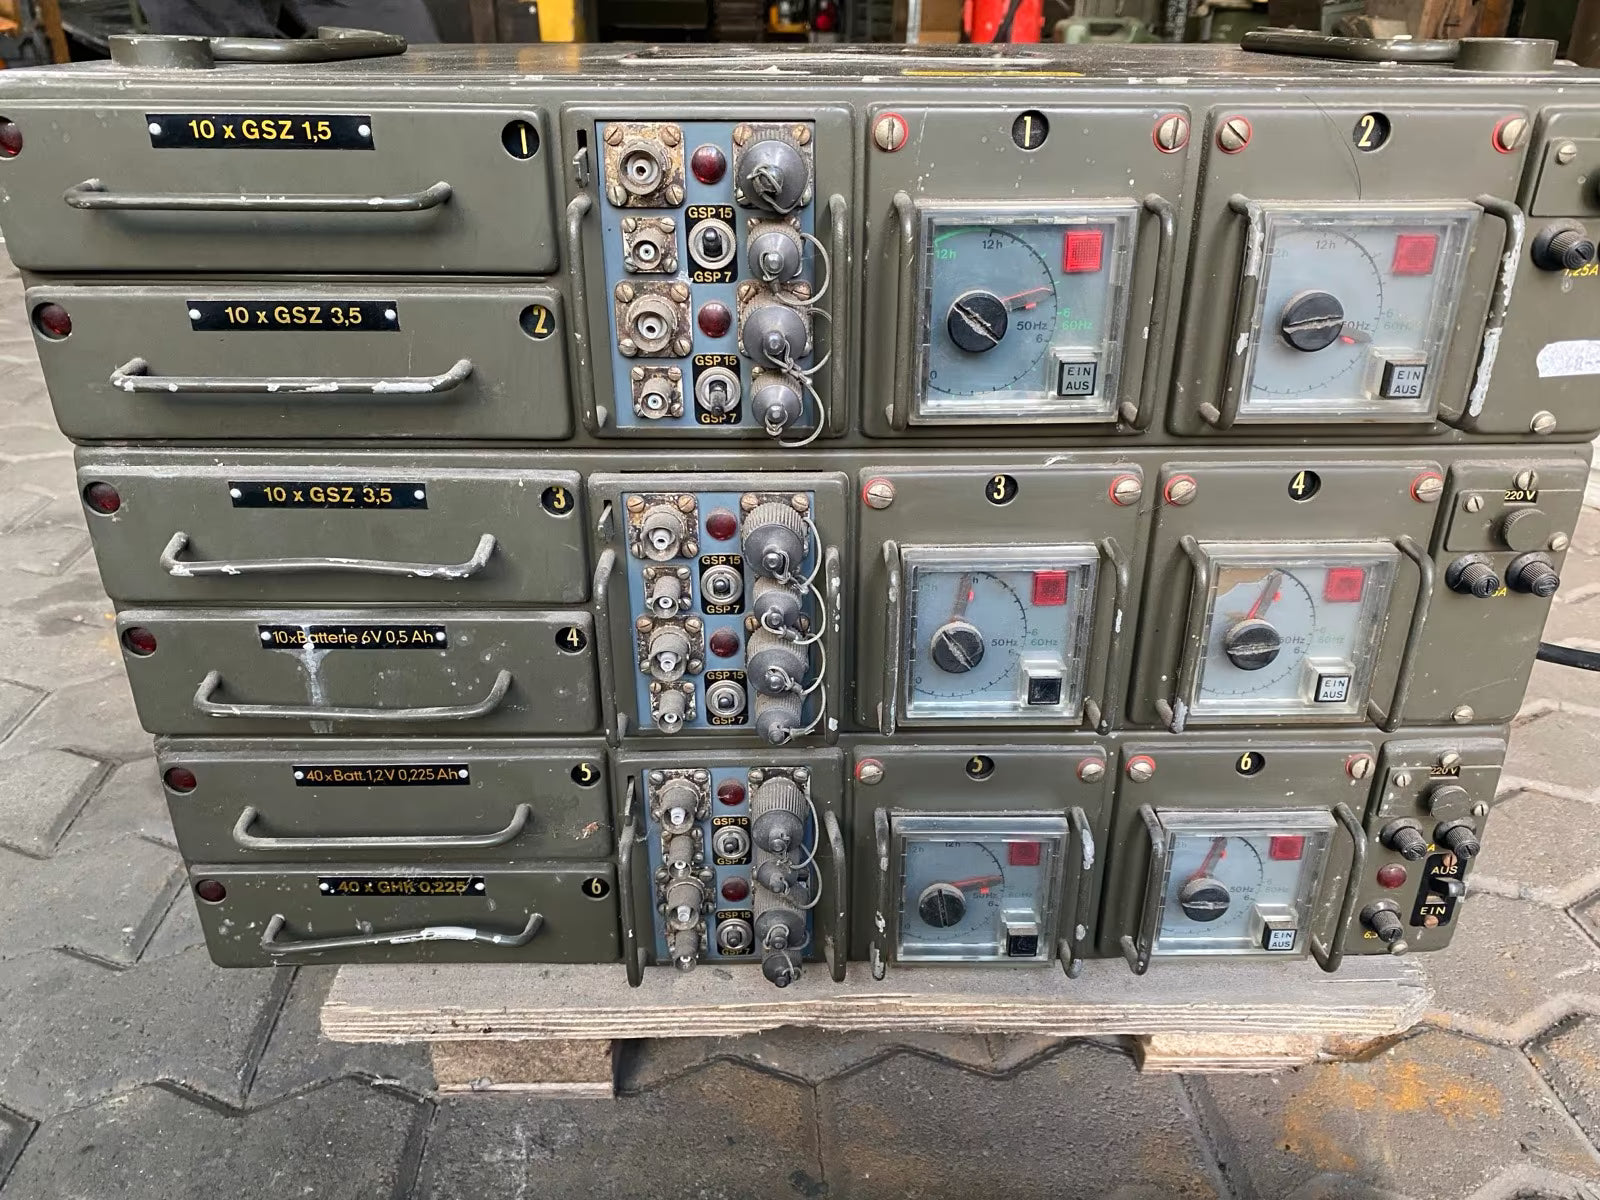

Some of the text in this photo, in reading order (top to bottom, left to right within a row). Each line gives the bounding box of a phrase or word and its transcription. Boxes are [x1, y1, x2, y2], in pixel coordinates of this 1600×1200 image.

[188, 119, 332, 143] 10 x GSZ 1,5
[1024, 115, 1032, 147] 1
[1358, 115, 1375, 147] 2
[518, 124, 528, 155] 1
[688, 206, 733, 219] GSP 15
[693, 271, 732, 283] GSP 7
[225, 306, 363, 327] 10 x GSZ 3,5
[533, 305, 548, 335] 2
[694, 355, 738, 366] GSP 15
[1067, 366, 1091, 376] EIN
[1396, 370, 1421, 381] EIN
[1065, 381, 1090, 391] AUS
[1392, 385, 1418, 395] AUS
[700, 413, 737, 424] GSP 7
[993, 475, 1006, 500] 3
[1292, 471, 1305, 495] 4
[263, 486, 394, 505] 10 x GSZ 3,5
[551, 486, 566, 509] 3
[1504, 490, 1537, 501] 220 V
[701, 555, 741, 565] GSP 15
[706, 605, 740, 614] GSP 7
[361, 630, 382, 644] 6V
[385, 630, 408, 645] 0,5
[411, 630, 434, 644] Ah
[567, 626, 580, 647] 4
[706, 671, 745, 680] GSP 15
[1324, 679, 1346, 688] EIN
[1322, 690, 1343, 699] AUS
[712, 716, 744, 725] GSP 7
[971, 755, 984, 773] 5
[1240, 752, 1252, 771] 6
[581, 762, 593, 782] 5
[1430, 766, 1458, 775] 220 V
[713, 817, 748, 826] GSP 15
[717, 857, 747, 865] GSP 7
[1431, 865, 1458, 875] AUS
[338, 881, 359, 893] 40
[419, 881, 467, 894] 0,225
[591, 877, 602, 895] 6
[717, 911, 738, 919] GSP
[1420, 906, 1446, 916] EIN
